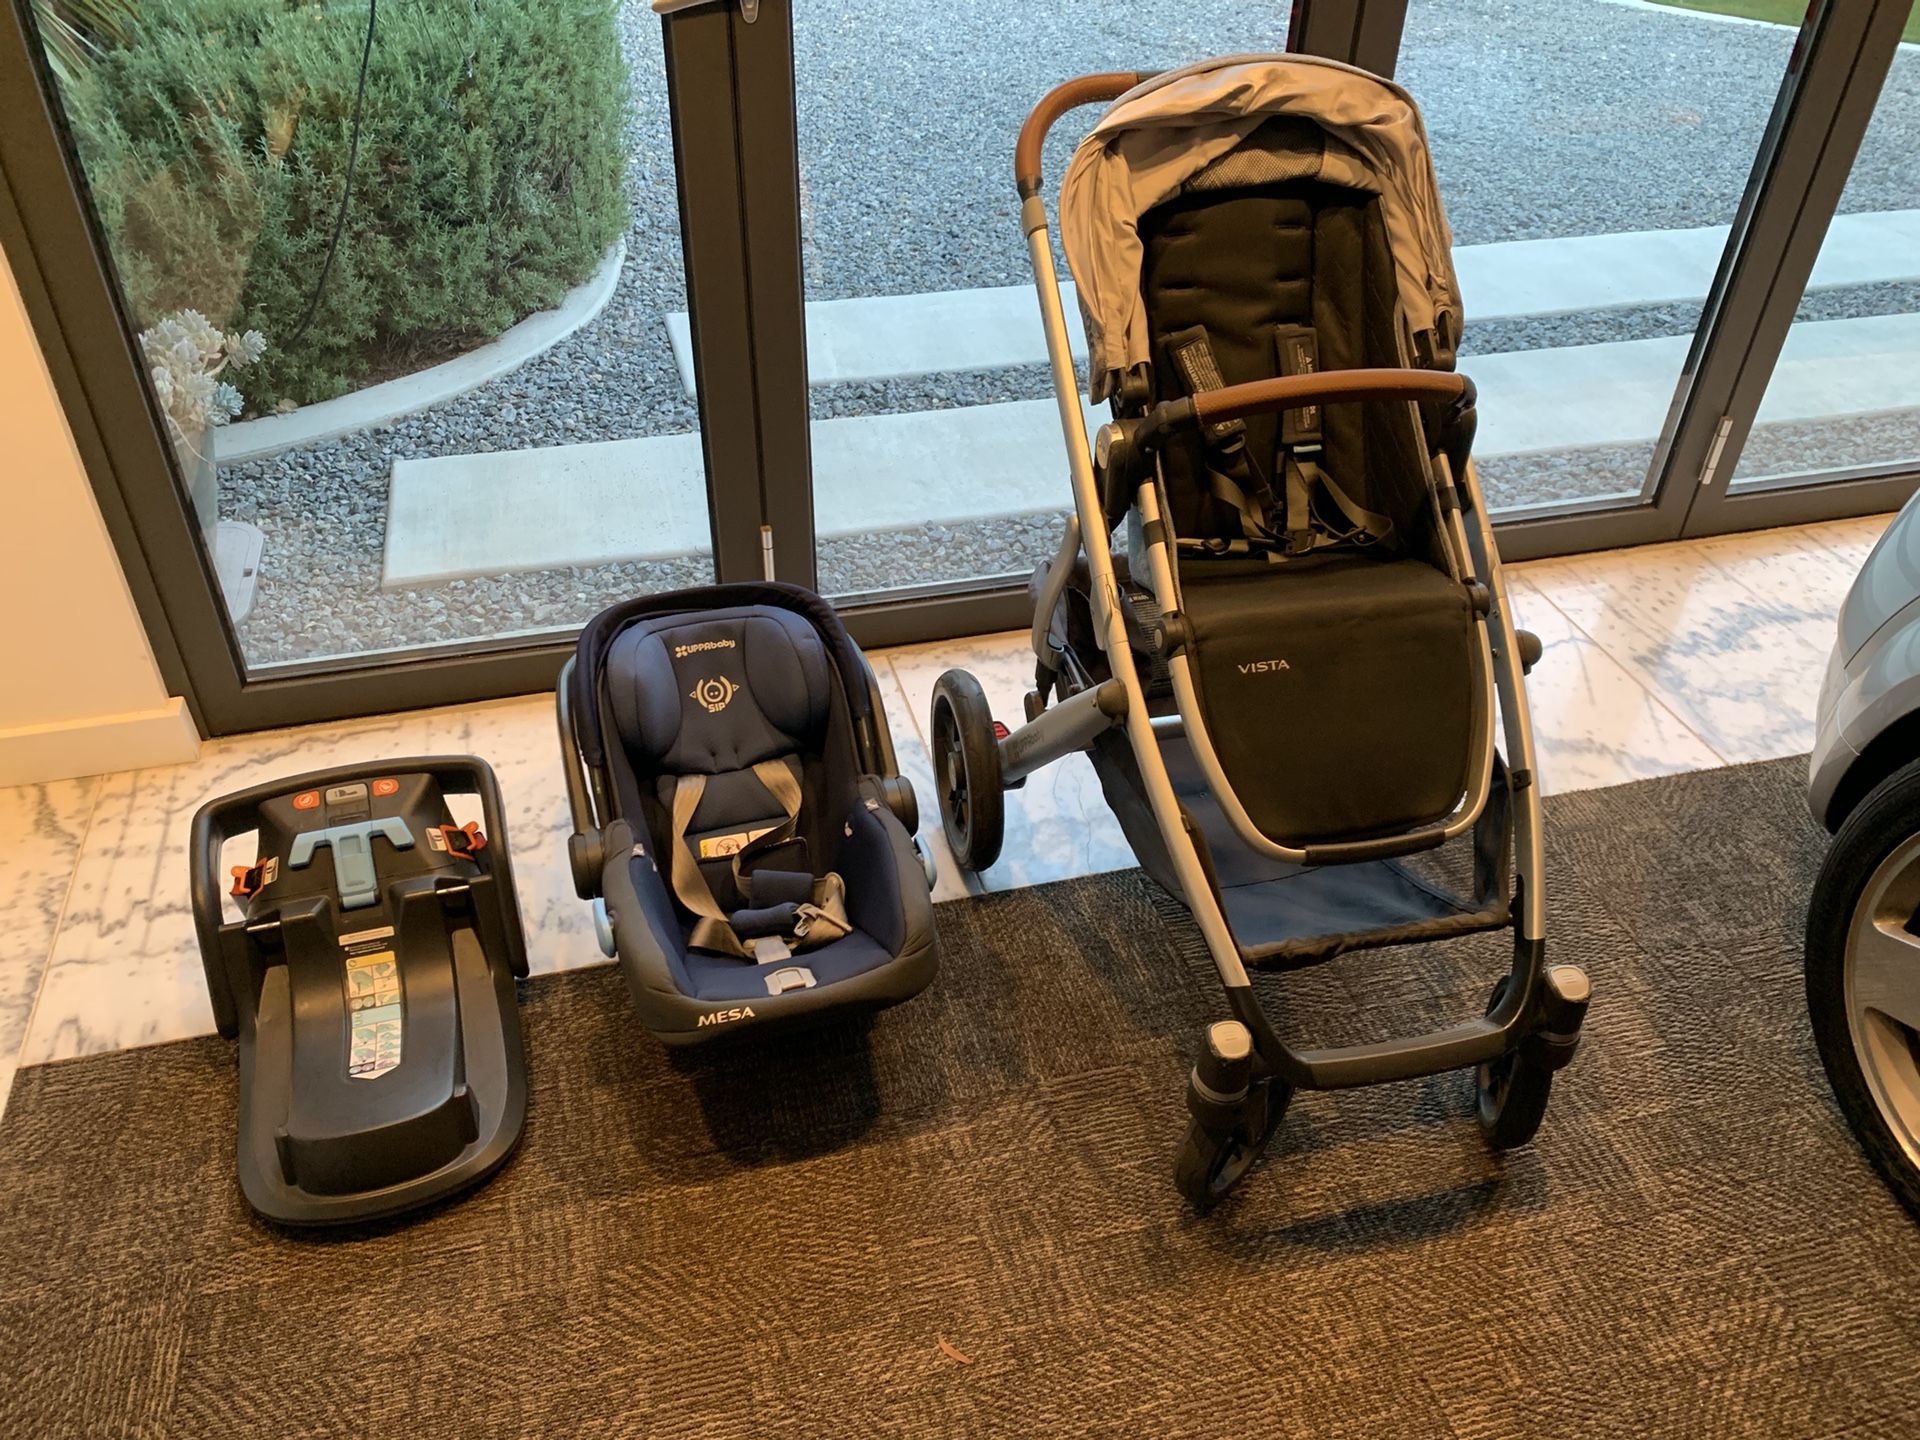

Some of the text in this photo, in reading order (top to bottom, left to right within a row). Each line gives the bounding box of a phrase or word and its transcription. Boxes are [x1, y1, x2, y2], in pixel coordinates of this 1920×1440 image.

[687, 639, 736, 653] UPPAbaby
[1238, 659, 1290, 673] VISTA
[708, 702, 725, 713] SIP
[697, 1006, 755, 1027] MESA
